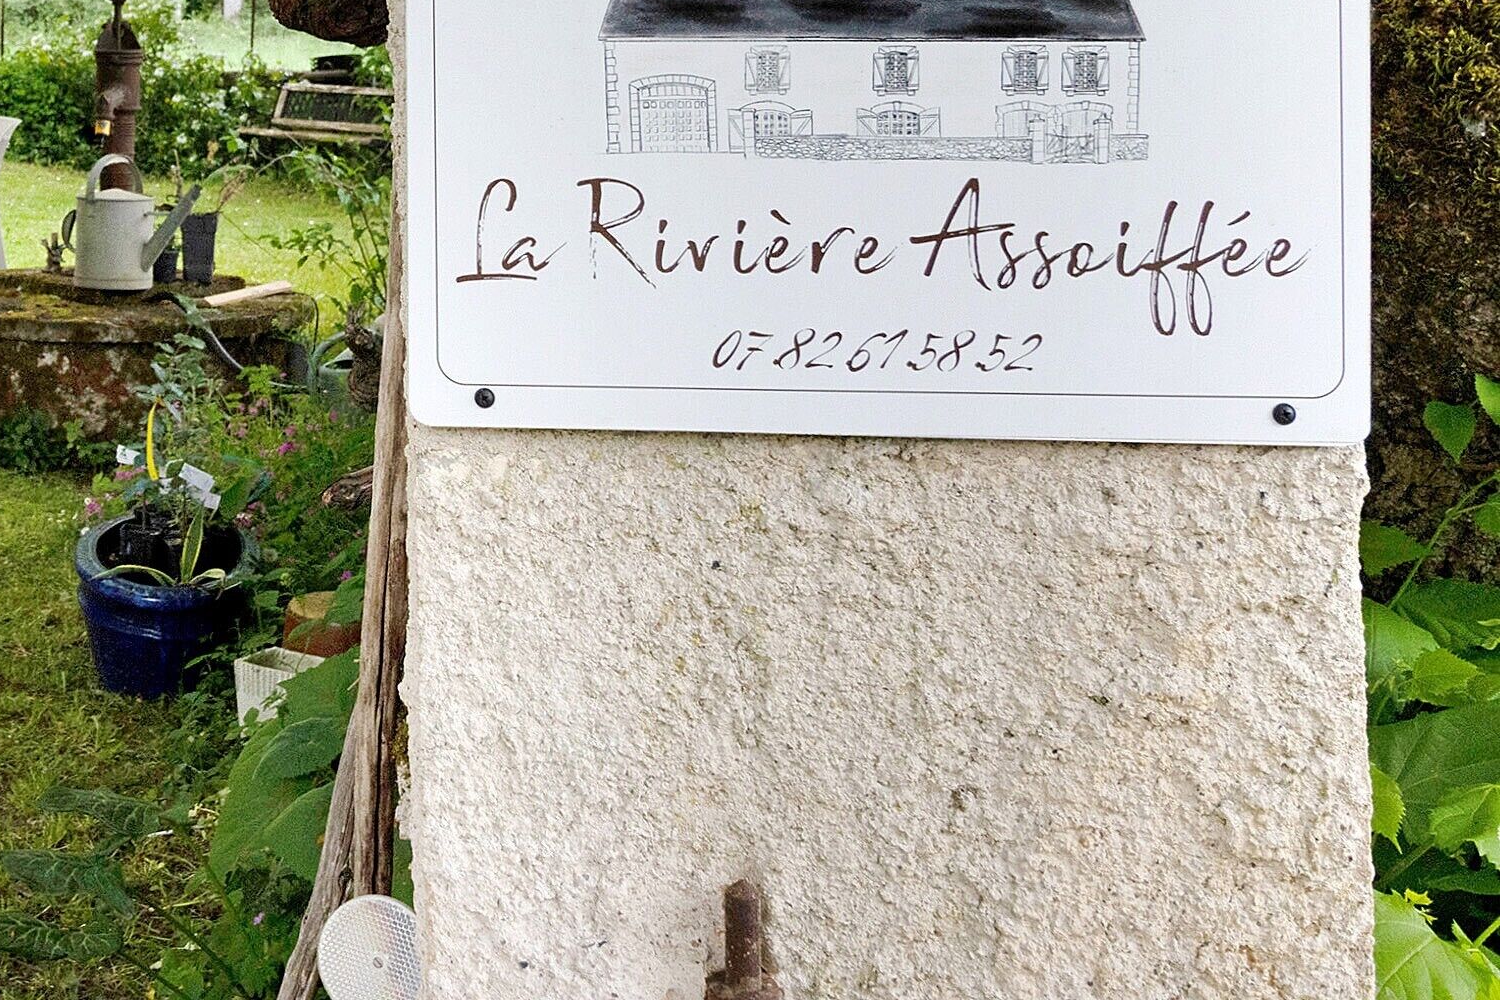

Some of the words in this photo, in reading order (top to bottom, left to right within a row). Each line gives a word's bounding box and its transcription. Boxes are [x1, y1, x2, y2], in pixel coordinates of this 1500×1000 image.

[455, 178, 566, 285] La
[577, 177, 902, 289] Rivière
[910, 177, 1311, 337] Assoiffée
